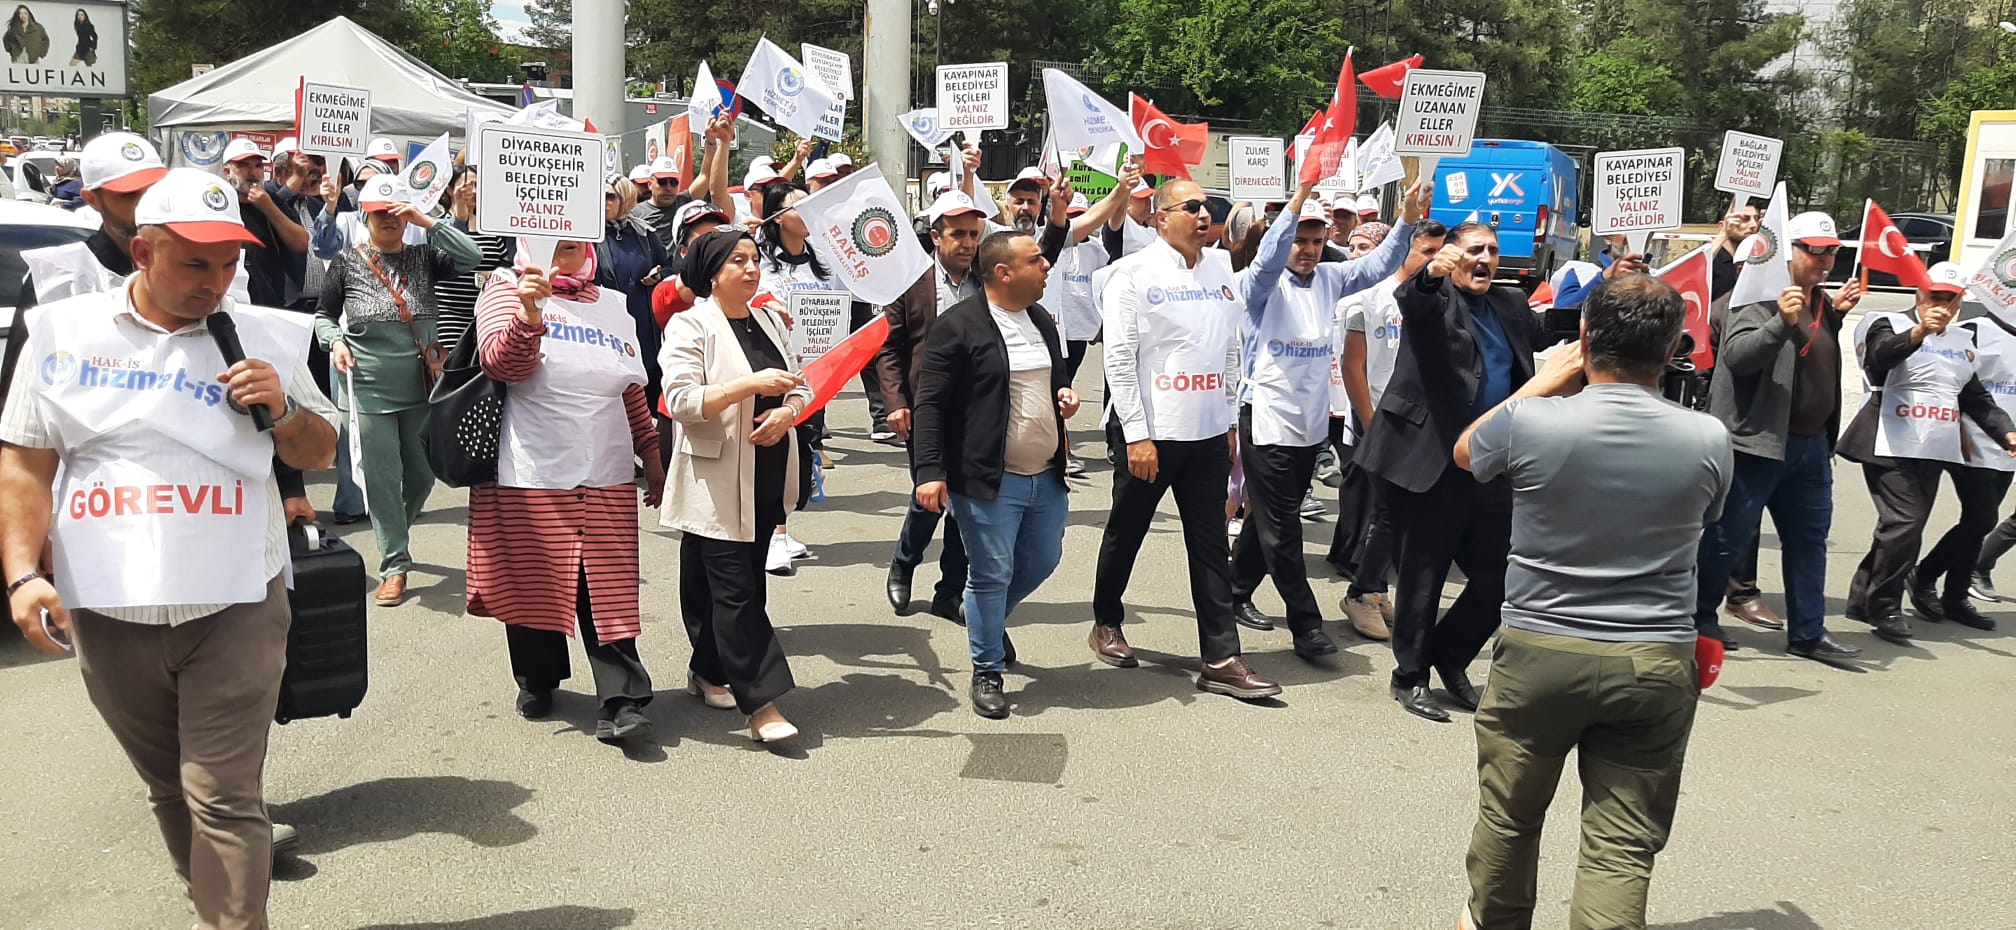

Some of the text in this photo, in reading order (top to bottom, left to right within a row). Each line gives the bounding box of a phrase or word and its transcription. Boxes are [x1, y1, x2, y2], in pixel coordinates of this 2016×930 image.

[8, 67, 105, 88] LUFIAN
[944, 69, 999, 81] KAYAPINAR
[945, 78, 998, 92] BELEDİYESİ
[1410, 82, 1477, 98] EKMEĞİME
[310, 92, 366, 108] EKMEĞİME
[953, 90, 990, 104] İŞÇİLERİ
[315, 106, 359, 121] UZANAN
[828, 102, 843, 115] LAR
[955, 103, 989, 114] YALNIZ
[1414, 100, 1466, 115] UZANAN
[950, 114, 994, 126] DEĞİLDİR
[1419, 117, 1454, 131] ELLER
[321, 122, 351, 134] ELLER
[310, 134, 353, 148] KIRILSIN
[501, 135, 583, 156] DİYARBAKIR
[1405, 133, 1455, 147] KIRILSIN
[1739, 139, 1768, 151] BAĞLAR
[1245, 146, 1271, 156] ZULME
[1732, 147, 1772, 161] BELEDİYESİ
[499, 152, 585, 172] BÜYÜKŞEHİR
[1247, 157, 1269, 168] KARŞI
[1606, 156, 1673, 171] KAYAPINAR
[505, 171, 580, 188] BELEDİYESİ
[1607, 168, 1672, 185] BELEDİYESİ
[1736, 168, 1760, 179] YALNIZ
[1234, 176, 1281, 187] DİRENECEĞİZ
[1729, 176, 1762, 189] DEĞİLDİR
[515, 184, 568, 202] İŞÇİLERİ
[1616, 184, 1662, 201] İŞÇİLERİ
[519, 201, 565, 216] YALNIZ
[1618, 200, 1659, 213] YALNIZ
[510, 214, 572, 231] DEĞİLDİR
[1610, 212, 1665, 228] DEĞİLDİR
[828, 224, 870, 279] HAK-İŞ
[1165, 286, 1224, 302] hizmet-iş
[800, 297, 841, 306] DİYARBAKIR
[799, 306, 841, 317] BÜYÜKŞEHİR
[801, 317, 838, 327] BELEDİYESİ
[806, 326, 832, 336] İŞÇİLERİ
[807, 337, 830, 345] YALNIZ
[79, 359, 222, 407] hizmet-iş
[69, 479, 243, 520] GÖREVLİ
